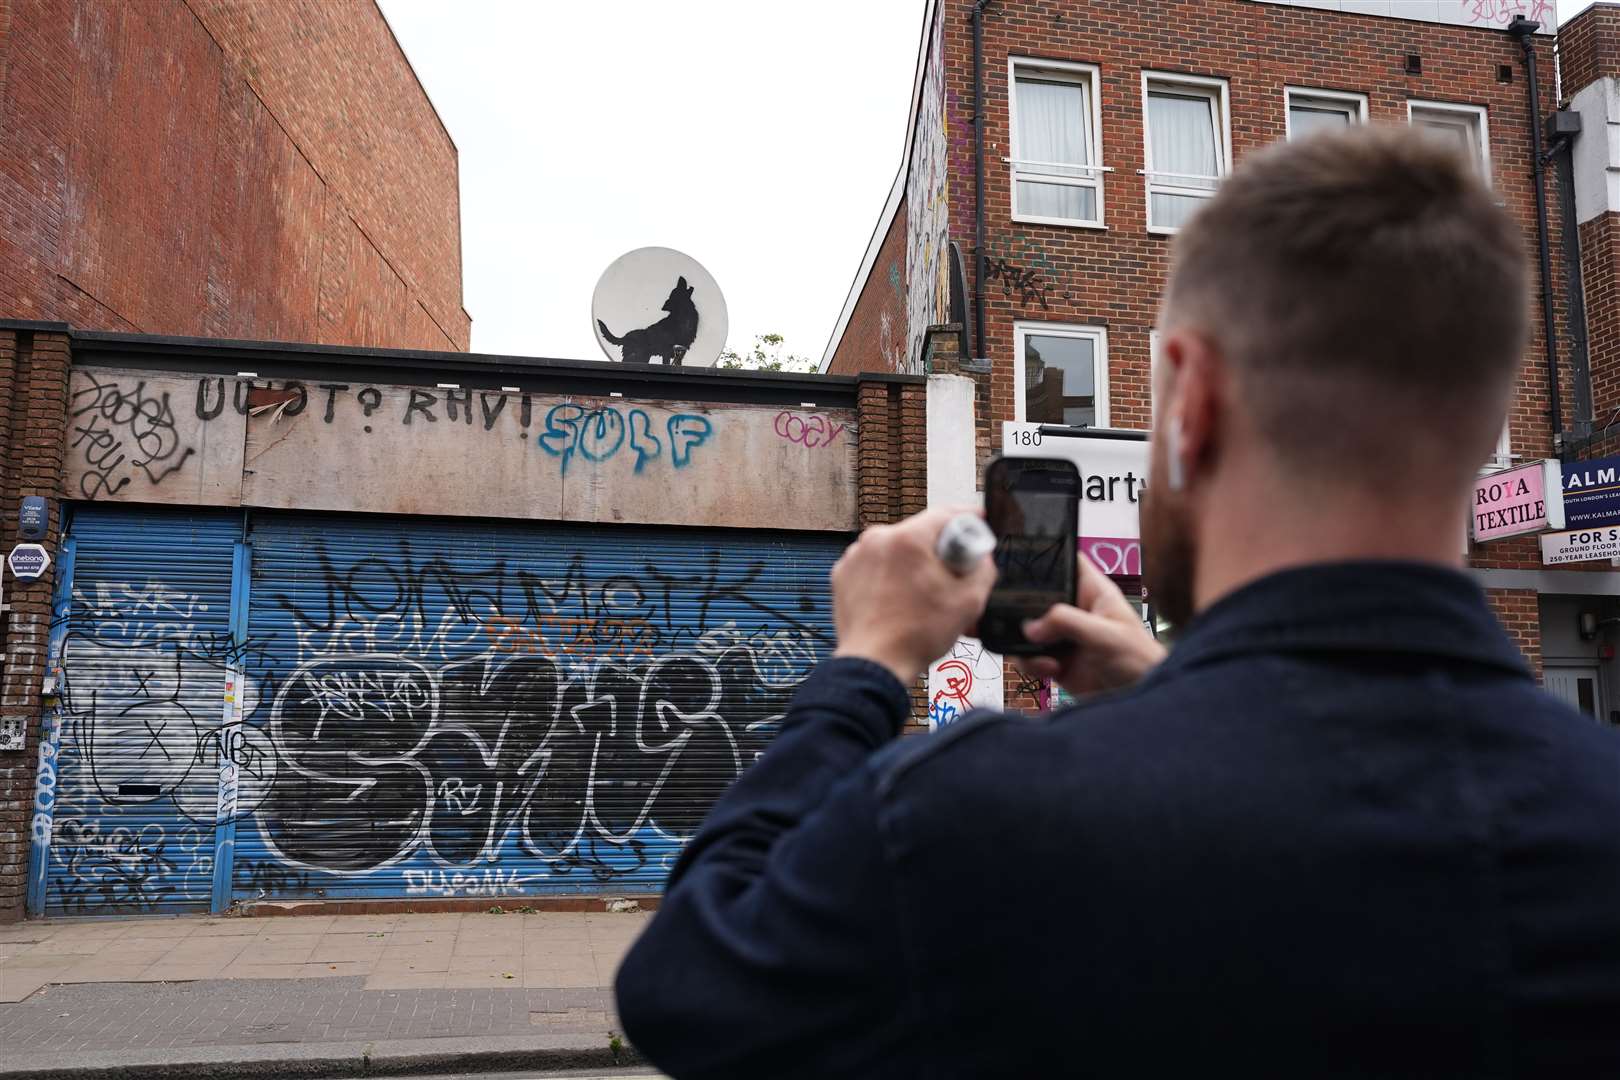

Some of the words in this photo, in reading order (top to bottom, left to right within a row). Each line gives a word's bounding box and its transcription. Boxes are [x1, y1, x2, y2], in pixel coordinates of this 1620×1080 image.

[1012, 430, 1042, 446] 180
[1561, 467, 1620, 490] ALM
[1079, 471, 1148, 503] art
[1475, 478, 1530, 506] ROYA
[1563, 497, 1580, 505] OUTH
[1580, 493, 1608, 502] LONDON'S
[1609, 490, 1620, 498] LEA
[1476, 500, 1546, 532] TEXTILE
[1569, 530, 1602, 545] FOR
[1609, 529, 1620, 541] S
[1559, 545, 1590, 554] GROUND
[1592, 542, 1617, 551] FLOOR
[1550, 553, 1583, 563] 250-YEAR
